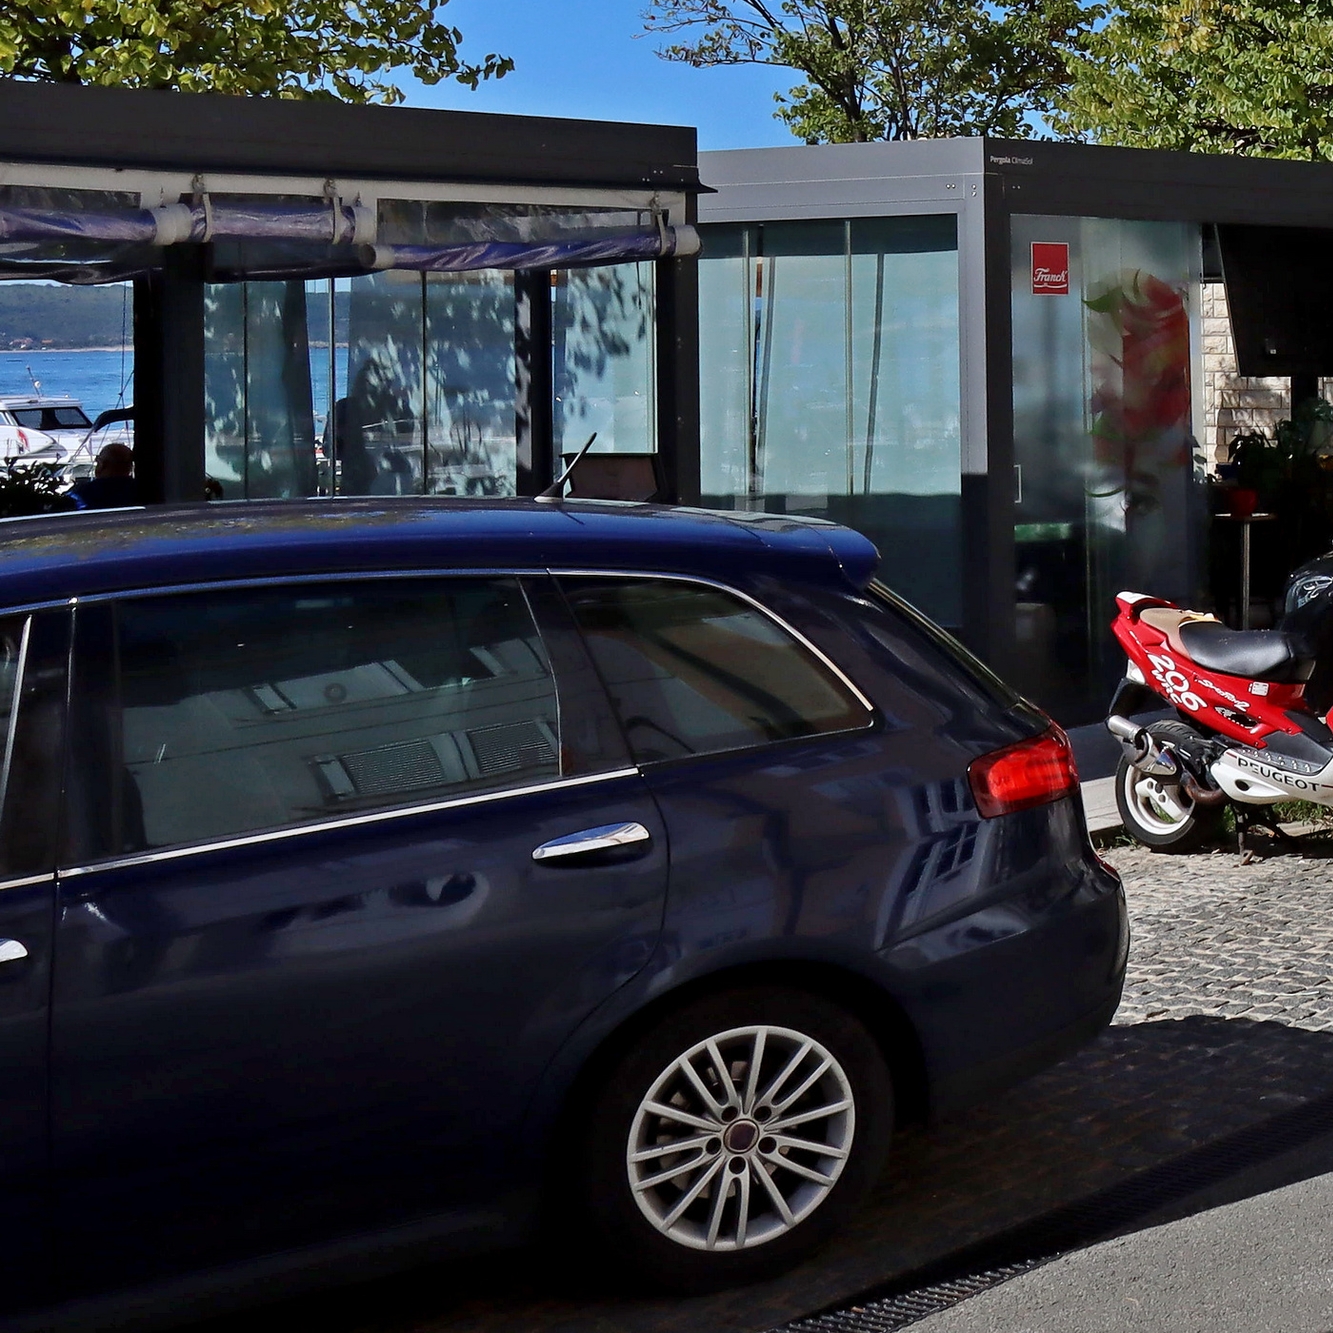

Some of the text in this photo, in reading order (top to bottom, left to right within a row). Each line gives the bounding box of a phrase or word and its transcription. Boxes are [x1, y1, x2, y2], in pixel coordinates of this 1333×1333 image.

[1034, 268, 1067, 282] Franck
[1147, 654, 1208, 711] 206
[1237, 757, 1320, 791] PEUGEOT
